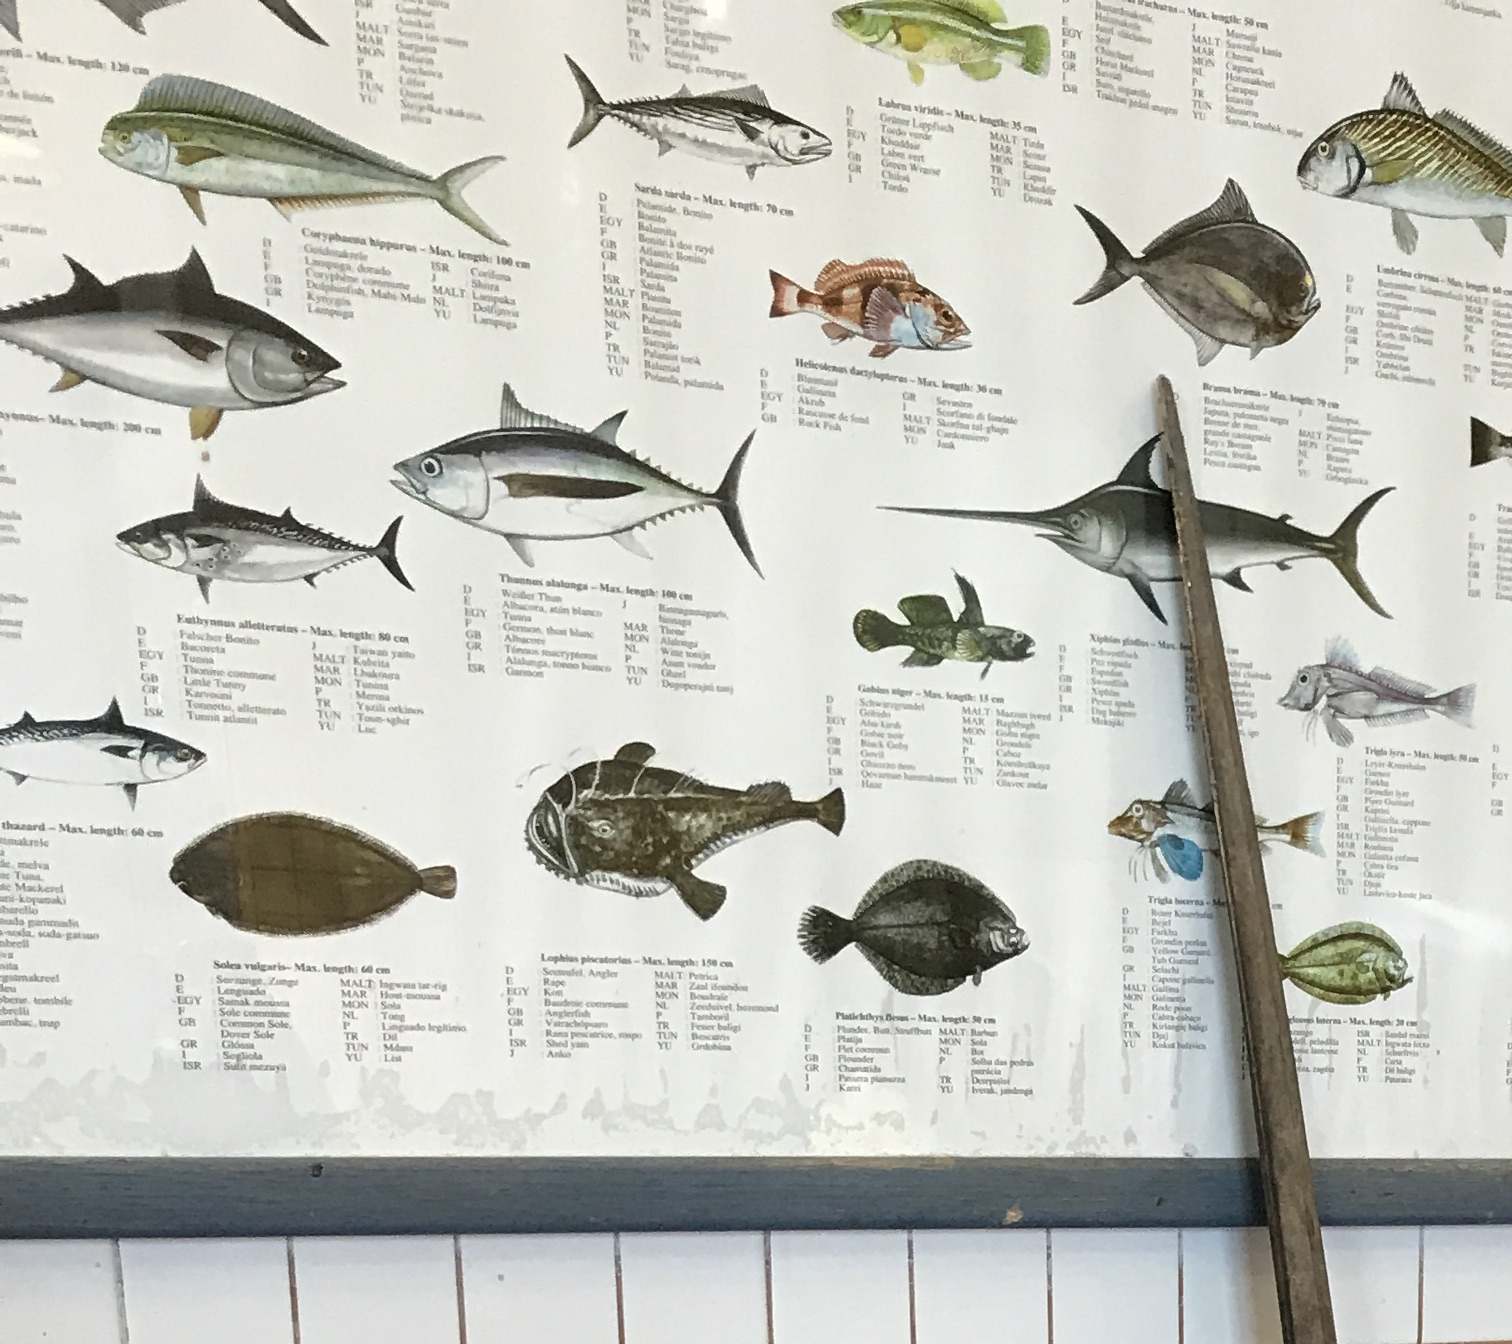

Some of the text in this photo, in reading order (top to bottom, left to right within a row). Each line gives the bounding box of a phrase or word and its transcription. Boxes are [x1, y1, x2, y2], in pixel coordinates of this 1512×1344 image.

[954, 109, 977, 122] Max.
[979, 114, 1009, 128] length:
[1012, 119, 1021, 130] 35
[1023, 123, 1037, 134] cm
[634, 183, 663, 197] Sarda
[702, 194, 725, 207] Max.
[729, 199, 763, 213] length:
[766, 203, 777, 213] 70
[780, 207, 793, 216] cm
[429, 244, 454, 258] Max.
[458, 249, 492, 264] length:
[496, 255, 513, 267] 100
[516, 259, 531, 269] cm
[600, 582, 624, 594] Max.
[626, 585, 658, 598] length:
[661, 589, 677, 599] 100
[679, 591, 693, 601] cm
[310, 625, 337, 637] Max.
[339, 629, 375, 642] length:
[378, 631, 391, 642] 80
[393, 634, 409, 644] cm
[923, 689, 944, 700] Max.
[946, 691, 976, 703] length:
[979, 694, 989, 703] 15
[991, 695, 1004, 704] cm
[1, 820, 163, 838] thazard Max. length: 60 cm
[213, 960, 241, 970] Solea
[295, 963, 321, 973] Max.
[323, 964, 358, 975] length:
[361, 965, 373, 974] 60
[642, 955, 665, 967] Max.
[667, 957, 699, 969] length:
[719, 960, 733, 968] cm
[918, 1015, 940, 1024] Max.
[942, 1015, 970, 1026] length:
[972, 1016, 982, 1024] 50
